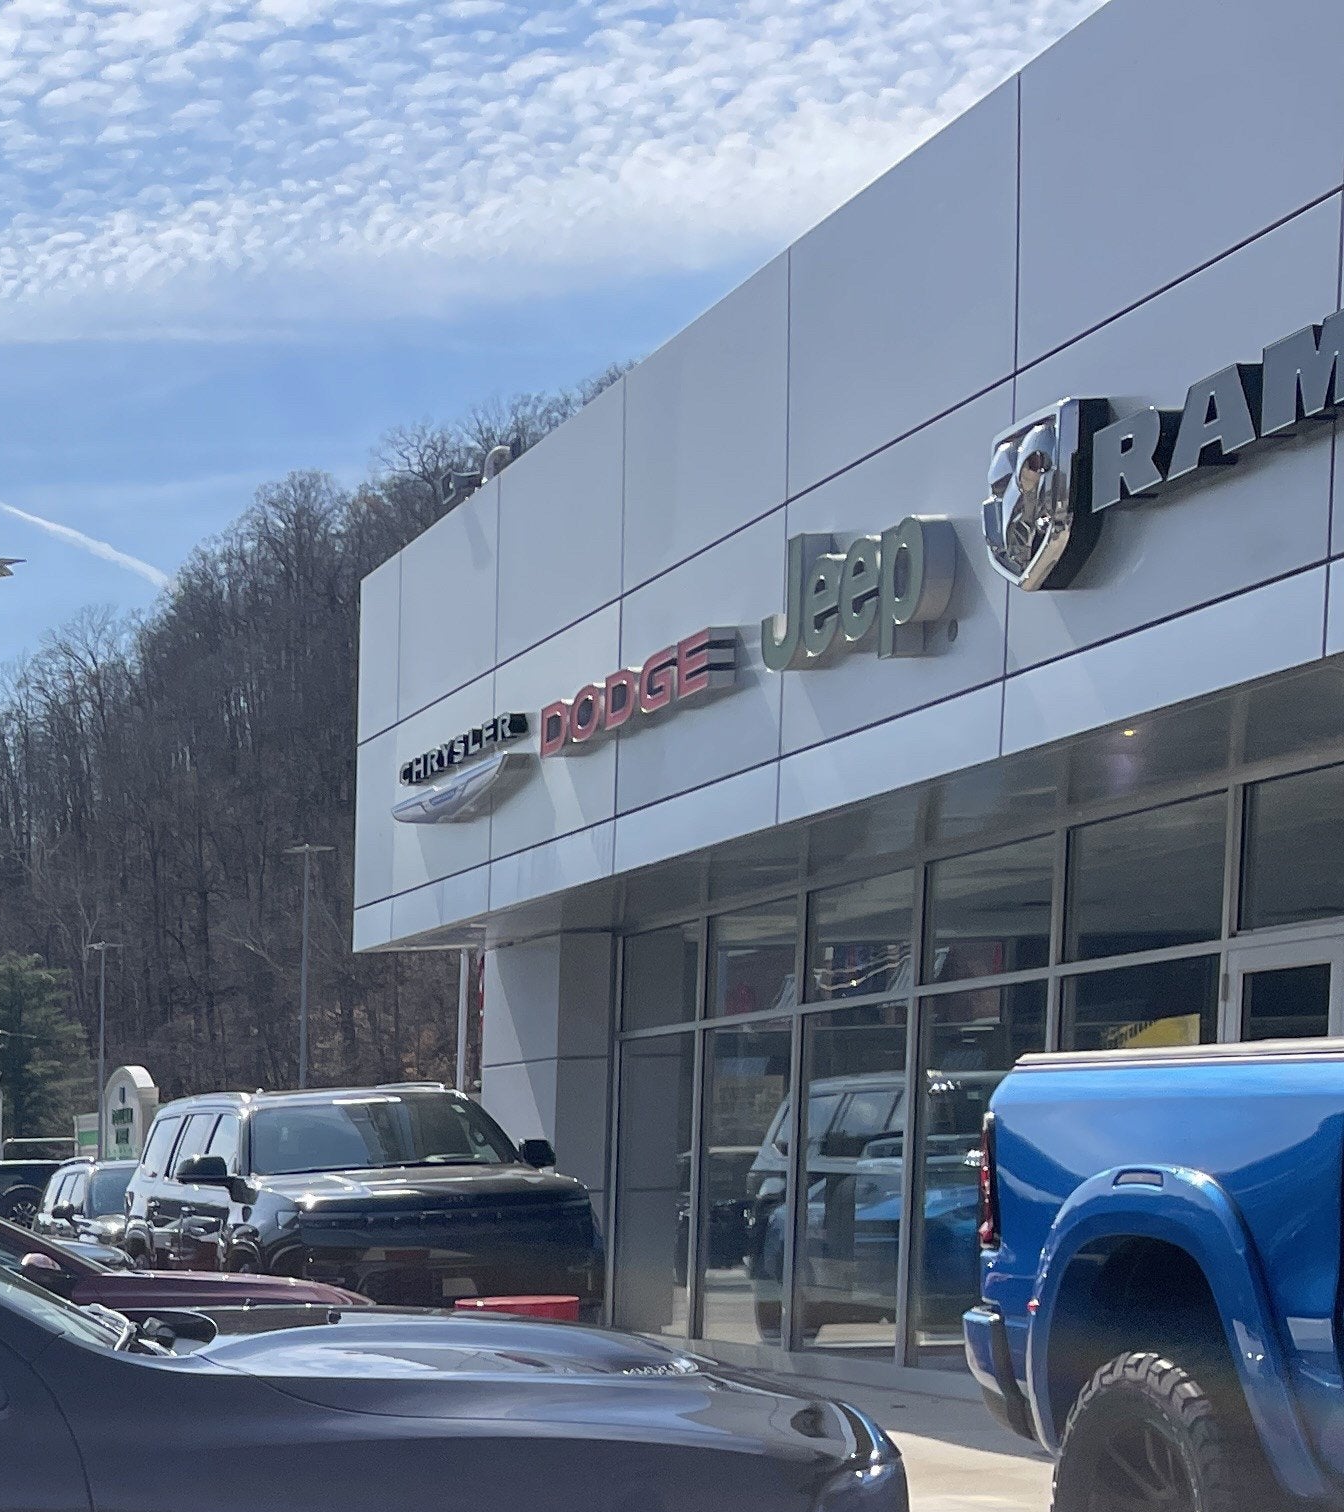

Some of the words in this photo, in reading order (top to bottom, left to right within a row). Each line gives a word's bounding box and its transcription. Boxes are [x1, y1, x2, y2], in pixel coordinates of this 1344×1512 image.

[1092, 306, 1344, 513] RAM
[761, 514, 955, 671] Jeep
[399, 712, 523, 786] CHRYSLER
[540, 626, 730, 758] DODGE
